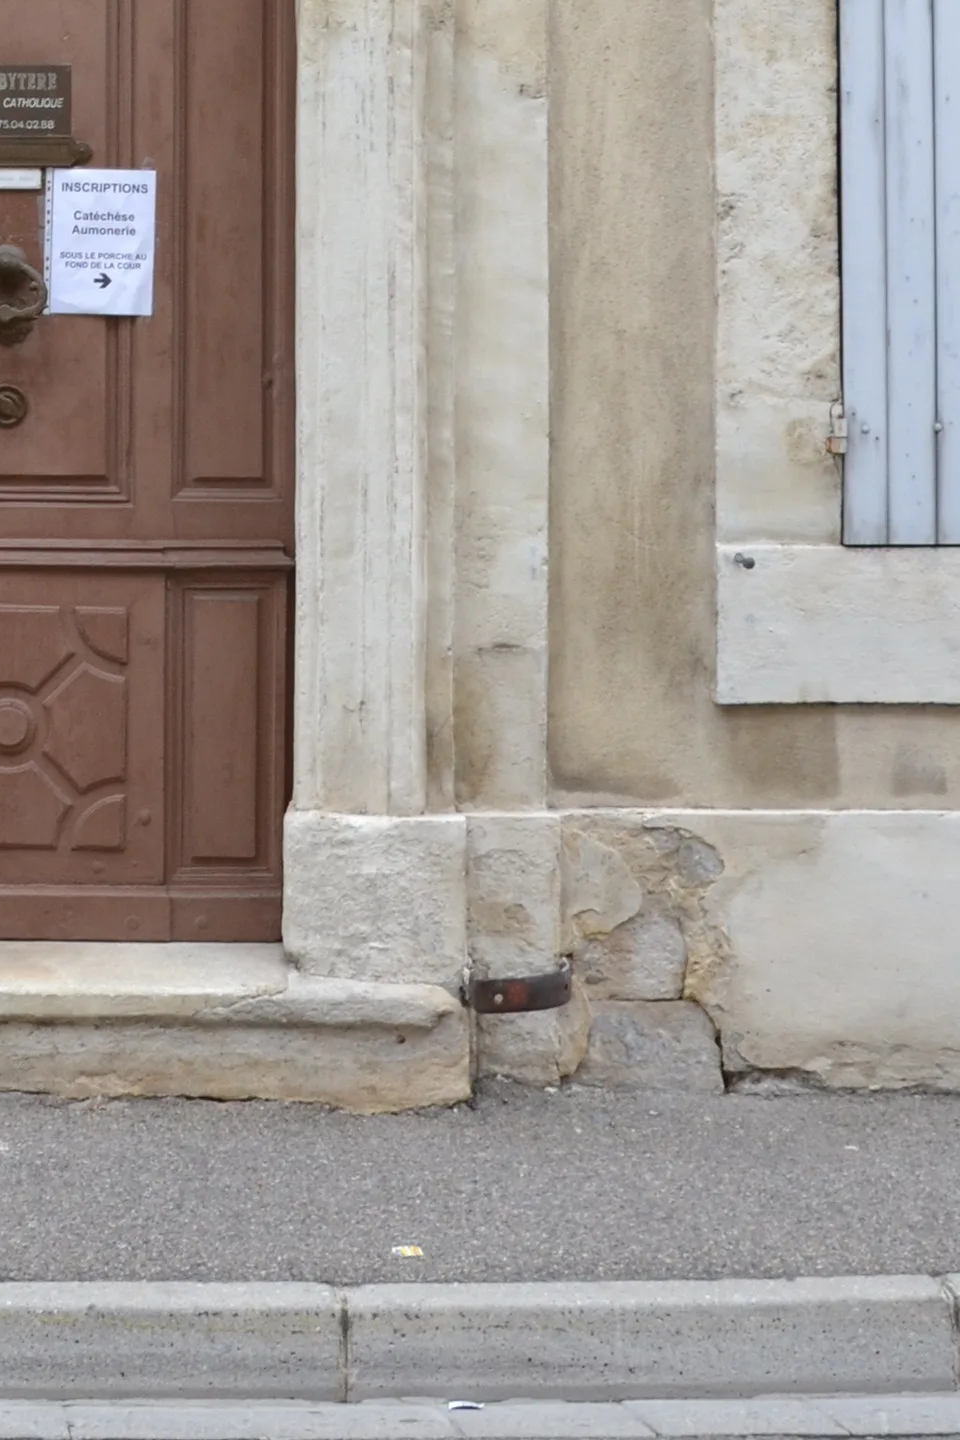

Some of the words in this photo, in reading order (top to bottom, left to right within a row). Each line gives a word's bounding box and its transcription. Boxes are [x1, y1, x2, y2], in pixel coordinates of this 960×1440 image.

[2, 97, 65, 108] CATHOLIQUE
[61, 182, 149, 194] INSCRIPTIONS
[73, 210, 135, 221] Catéchèse
[72, 225, 136, 236] Aumonerie
[60, 251, 83, 259] SOUS
[98, 252, 133, 260] PORCHE
[65, 261, 88, 269] FOND
[117, 262, 142, 270] COUR
